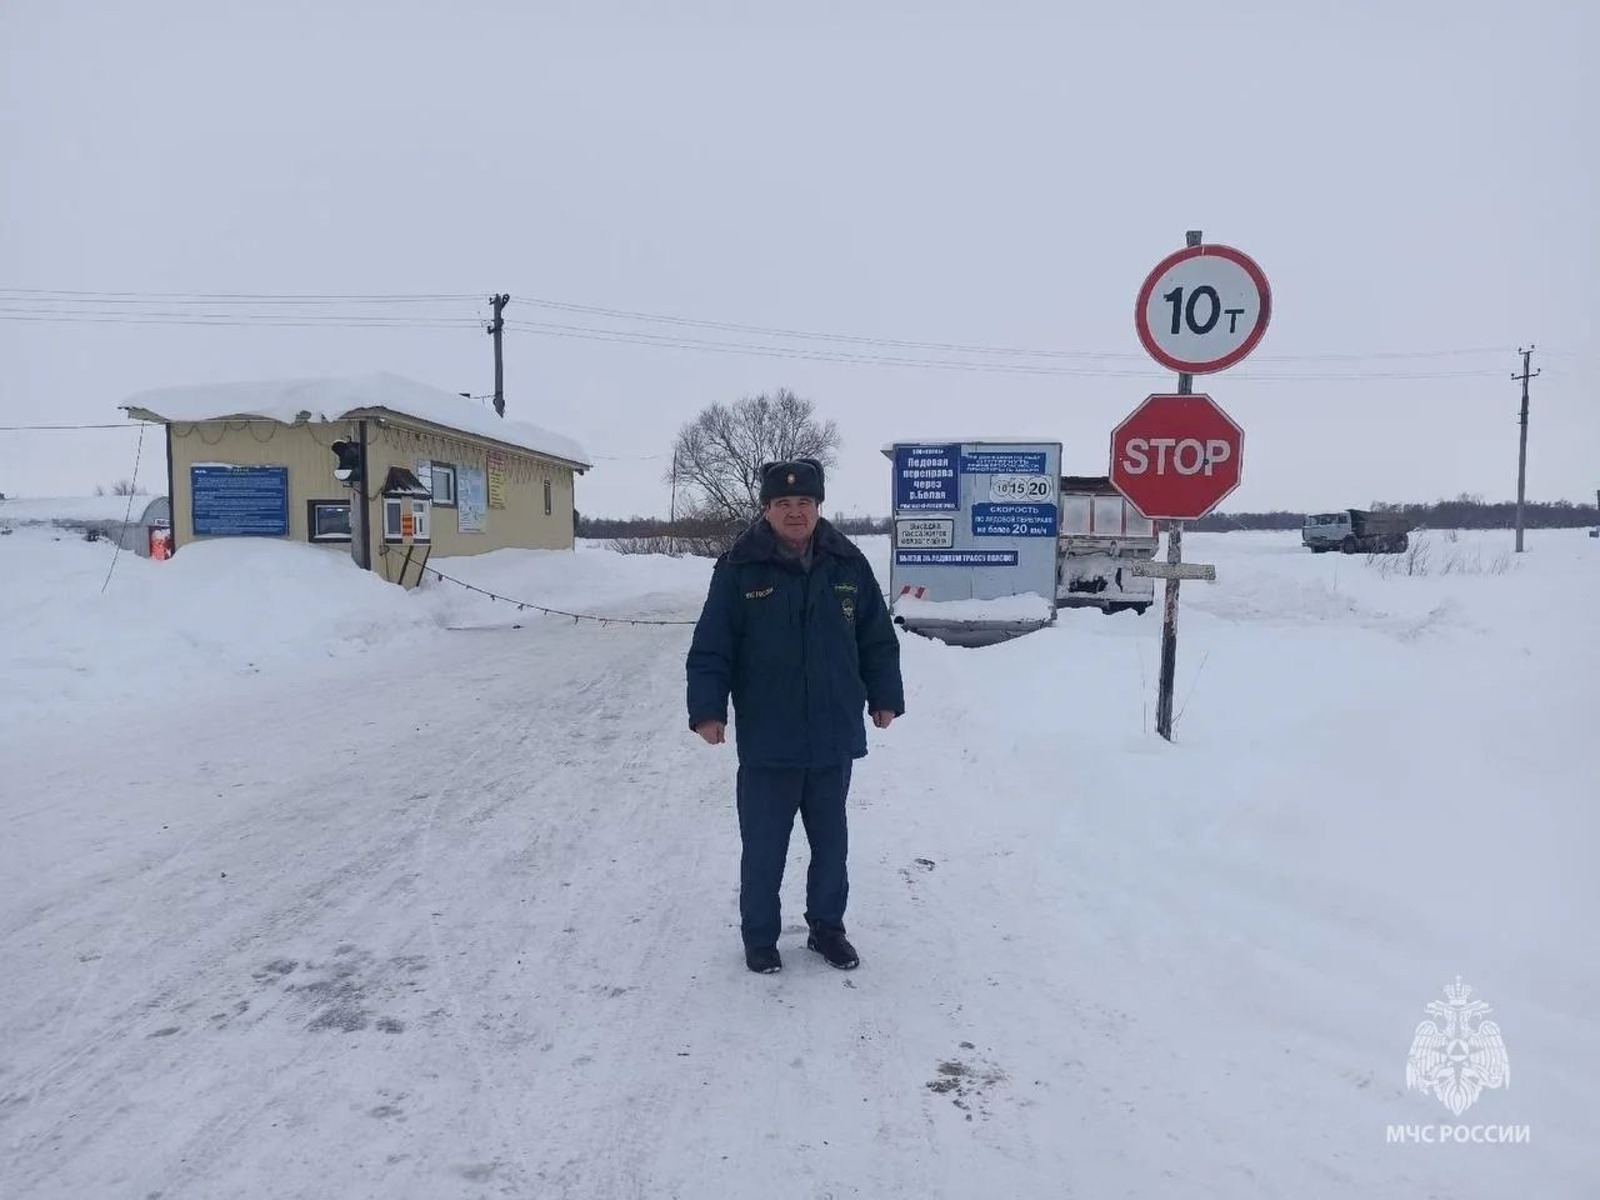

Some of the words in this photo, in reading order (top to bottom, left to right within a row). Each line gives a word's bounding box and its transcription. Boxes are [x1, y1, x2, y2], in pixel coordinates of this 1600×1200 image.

[1122, 437, 1231, 477] STOP
[903, 469, 953, 479] переправа
[913, 480, 942, 489] через
[997, 484, 1007, 492] 10
[1010, 482, 1025, 493] 15
[1028, 482, 1047, 495] 20
[990, 506, 1040, 514] СКОРОСТЬ
[1012, 524, 1028, 534] 20
